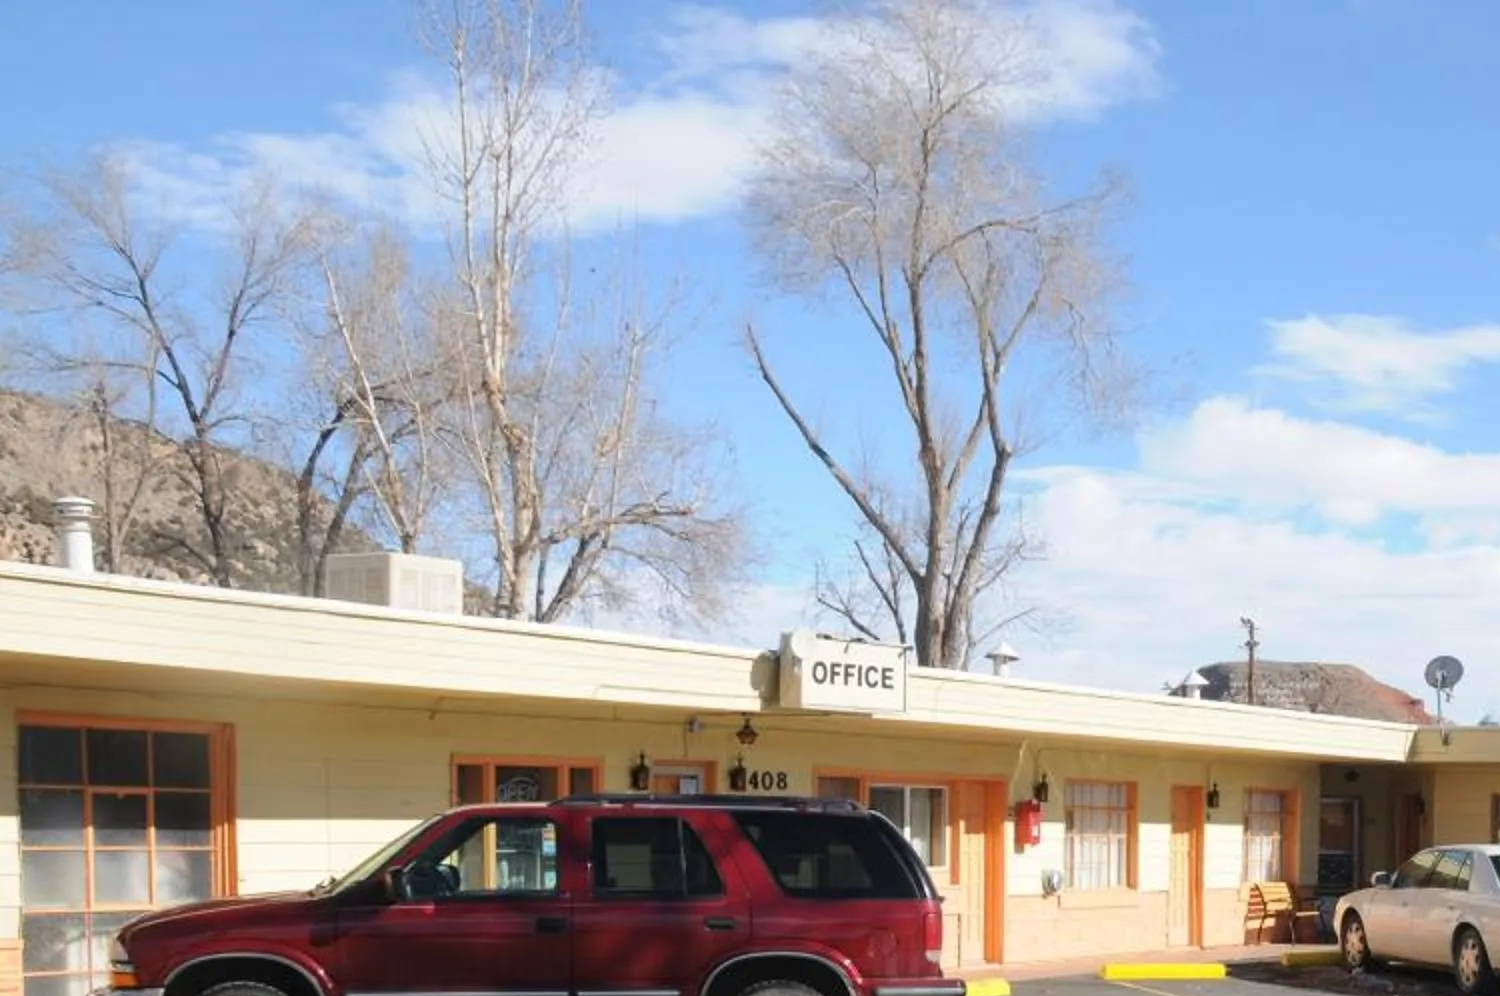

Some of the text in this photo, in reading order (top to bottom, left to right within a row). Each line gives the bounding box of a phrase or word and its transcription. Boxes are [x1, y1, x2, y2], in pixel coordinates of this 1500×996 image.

[811, 660, 895, 690] OFFICE
[748, 770, 788, 790] 408
[497, 782, 538, 801] OPEN
